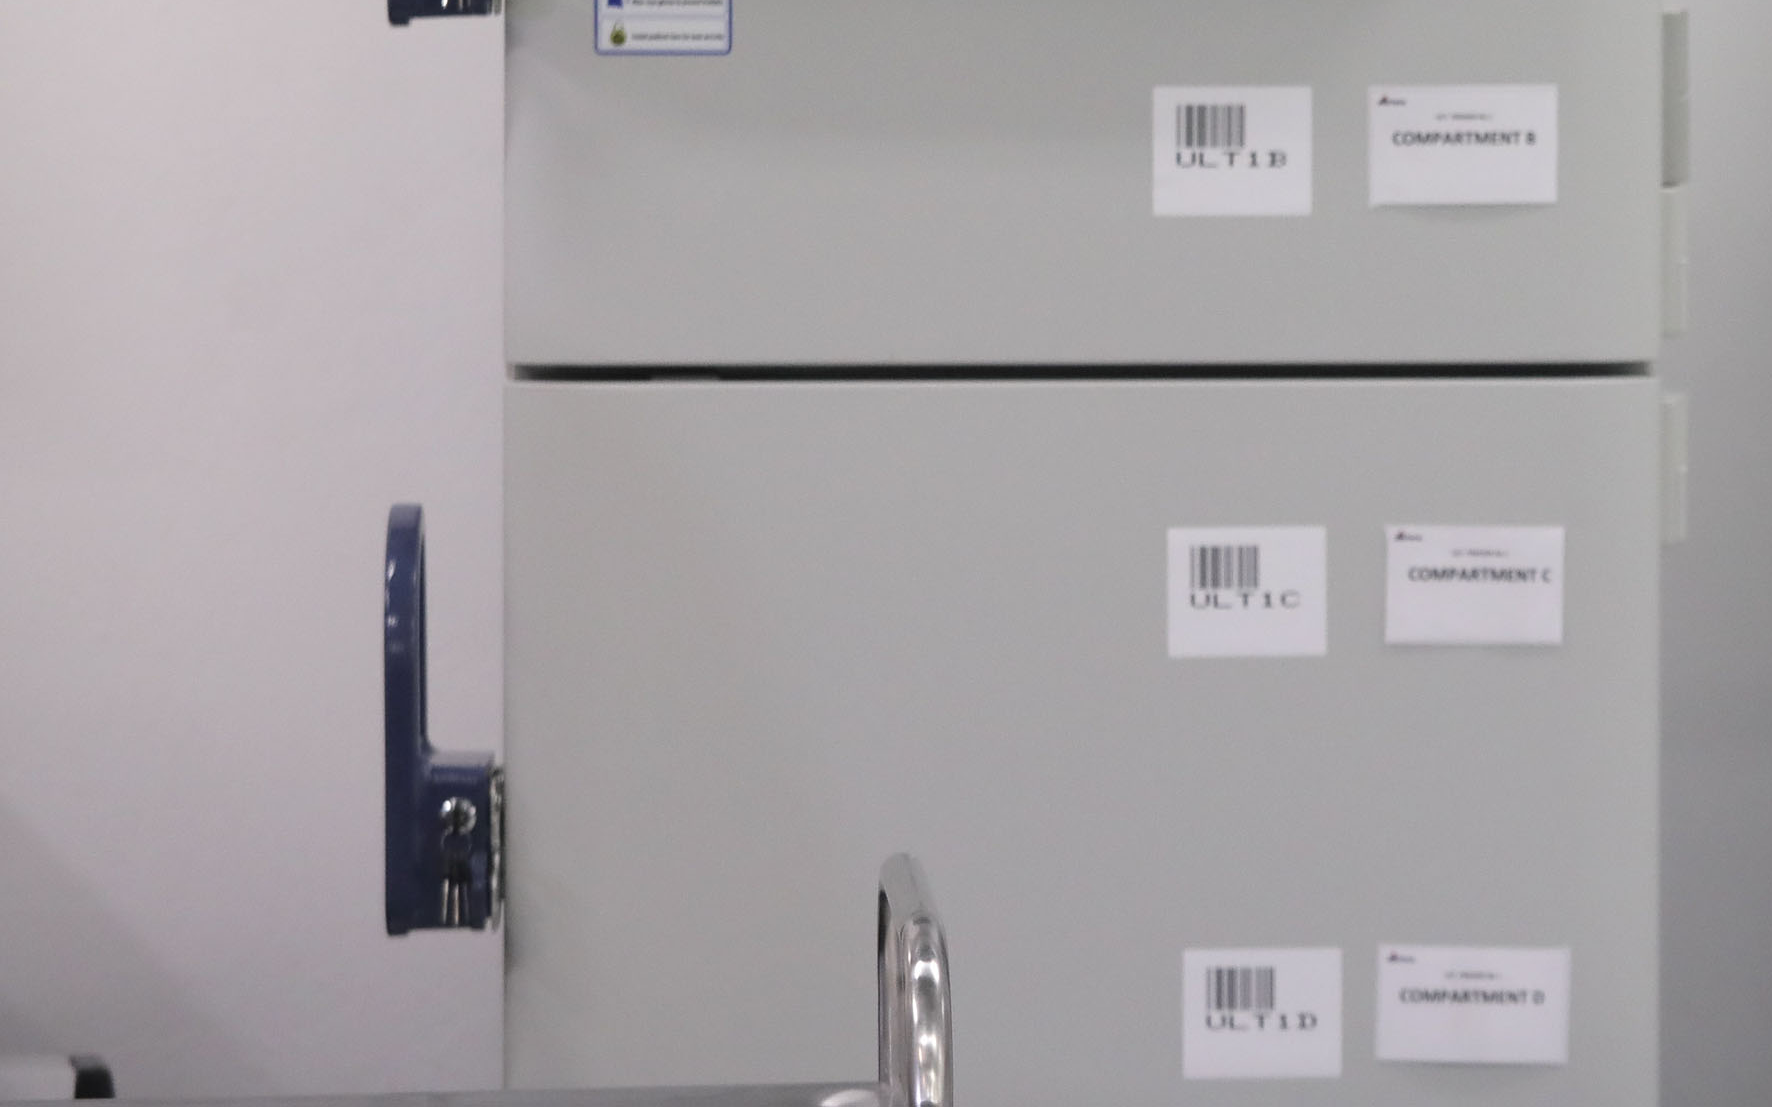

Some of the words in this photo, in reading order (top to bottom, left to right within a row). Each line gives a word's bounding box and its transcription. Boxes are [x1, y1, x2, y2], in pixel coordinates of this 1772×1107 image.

[1391, 131, 1521, 147] COMPARTMENT
[1175, 150, 1287, 168] ULT1B
[1407, 567, 1538, 583] COMPARTMENT
[1541, 567, 1551, 584] C
[1189, 592, 1300, 610] ULT1C
[1398, 989, 1528, 1004] COMPARTMENT
[1204, 1013, 1318, 1032] ULT1D
